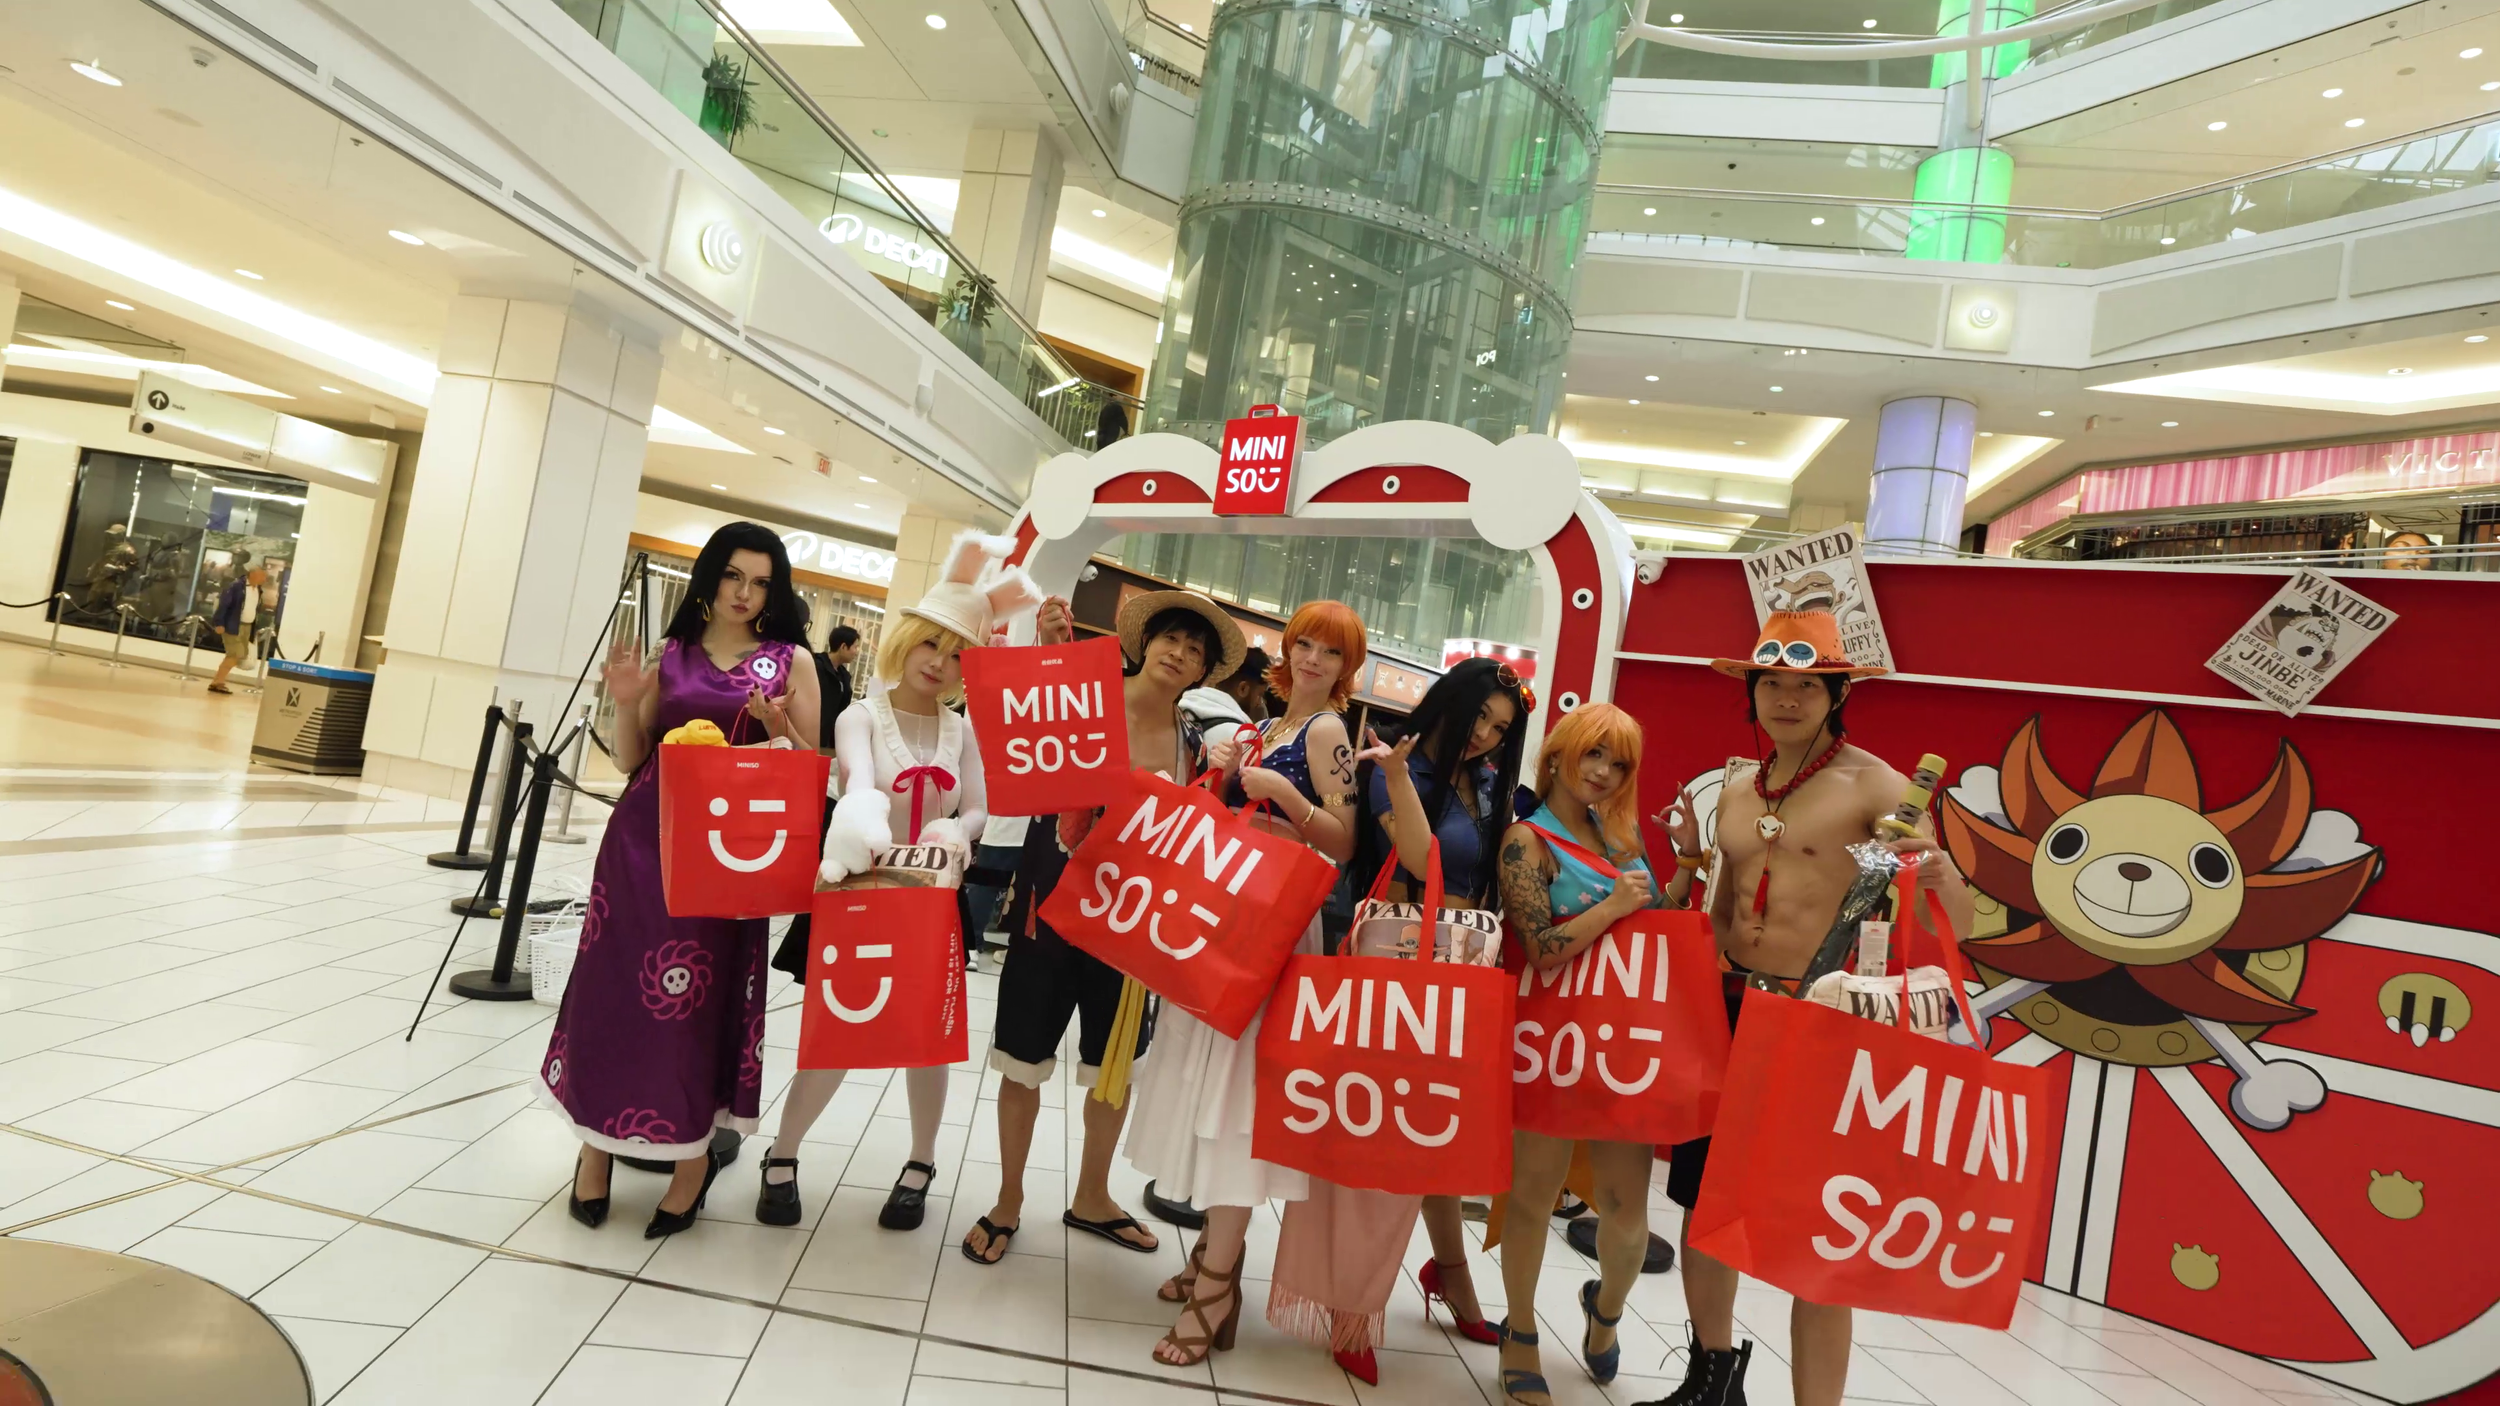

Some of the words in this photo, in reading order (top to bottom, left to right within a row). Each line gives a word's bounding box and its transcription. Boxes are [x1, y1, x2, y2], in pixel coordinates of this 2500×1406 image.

[818, 458, 831, 475] EXIT
[1229, 435, 1286, 461] MINI
[1748, 532, 1853, 580] WANTED
[2294, 572, 2387, 632] WANTED
[1840, 620, 1871, 635] LIVE
[1842, 633, 1872, 654] UFFY
[281, 663, 296, 671] STOP
[302, 666, 318, 674] SORT
[2238, 649, 2305, 690] JINBE
[2242, 635, 2267, 652] DEAD
[2271, 651, 2285, 662] OR
[2288, 662, 2320, 682] ALIVE
[1003, 681, 1104, 725] MINI
[2265, 689, 2295, 711] MARINE
[1117, 794, 1263, 896] MINI
[1360, 902, 1496, 934] WANTED
[1290, 976, 1466, 1058] MINI
[1832, 1048, 2027, 1183] MINI
